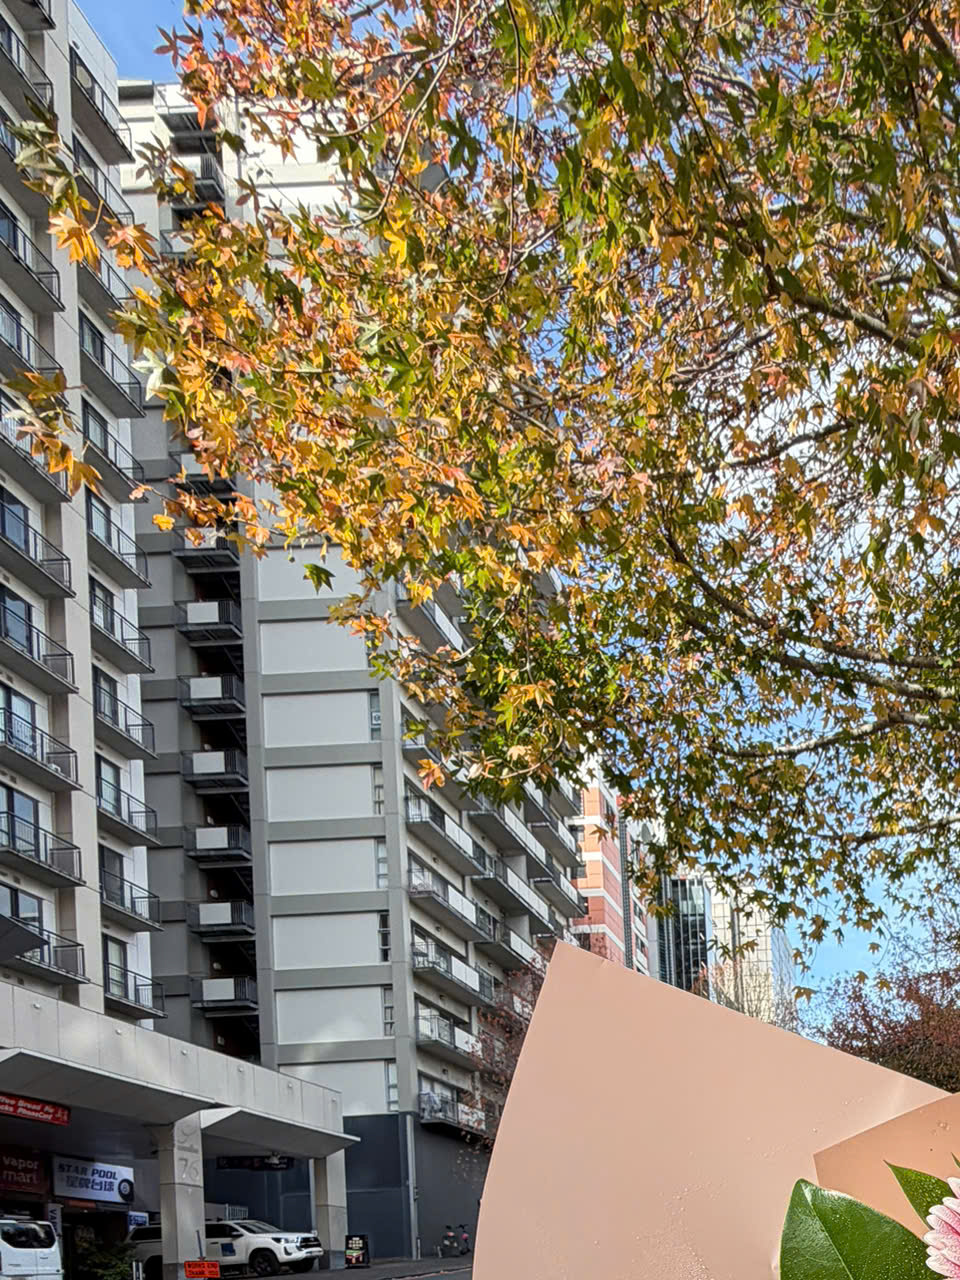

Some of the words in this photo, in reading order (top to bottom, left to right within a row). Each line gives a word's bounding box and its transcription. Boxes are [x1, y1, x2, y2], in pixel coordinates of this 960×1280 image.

[2, 1156, 40, 1170] vapor
[3, 1170, 39, 1184] mart
[58, 1163, 88, 1176] STAR
[91, 1168, 118, 1180] POOL
